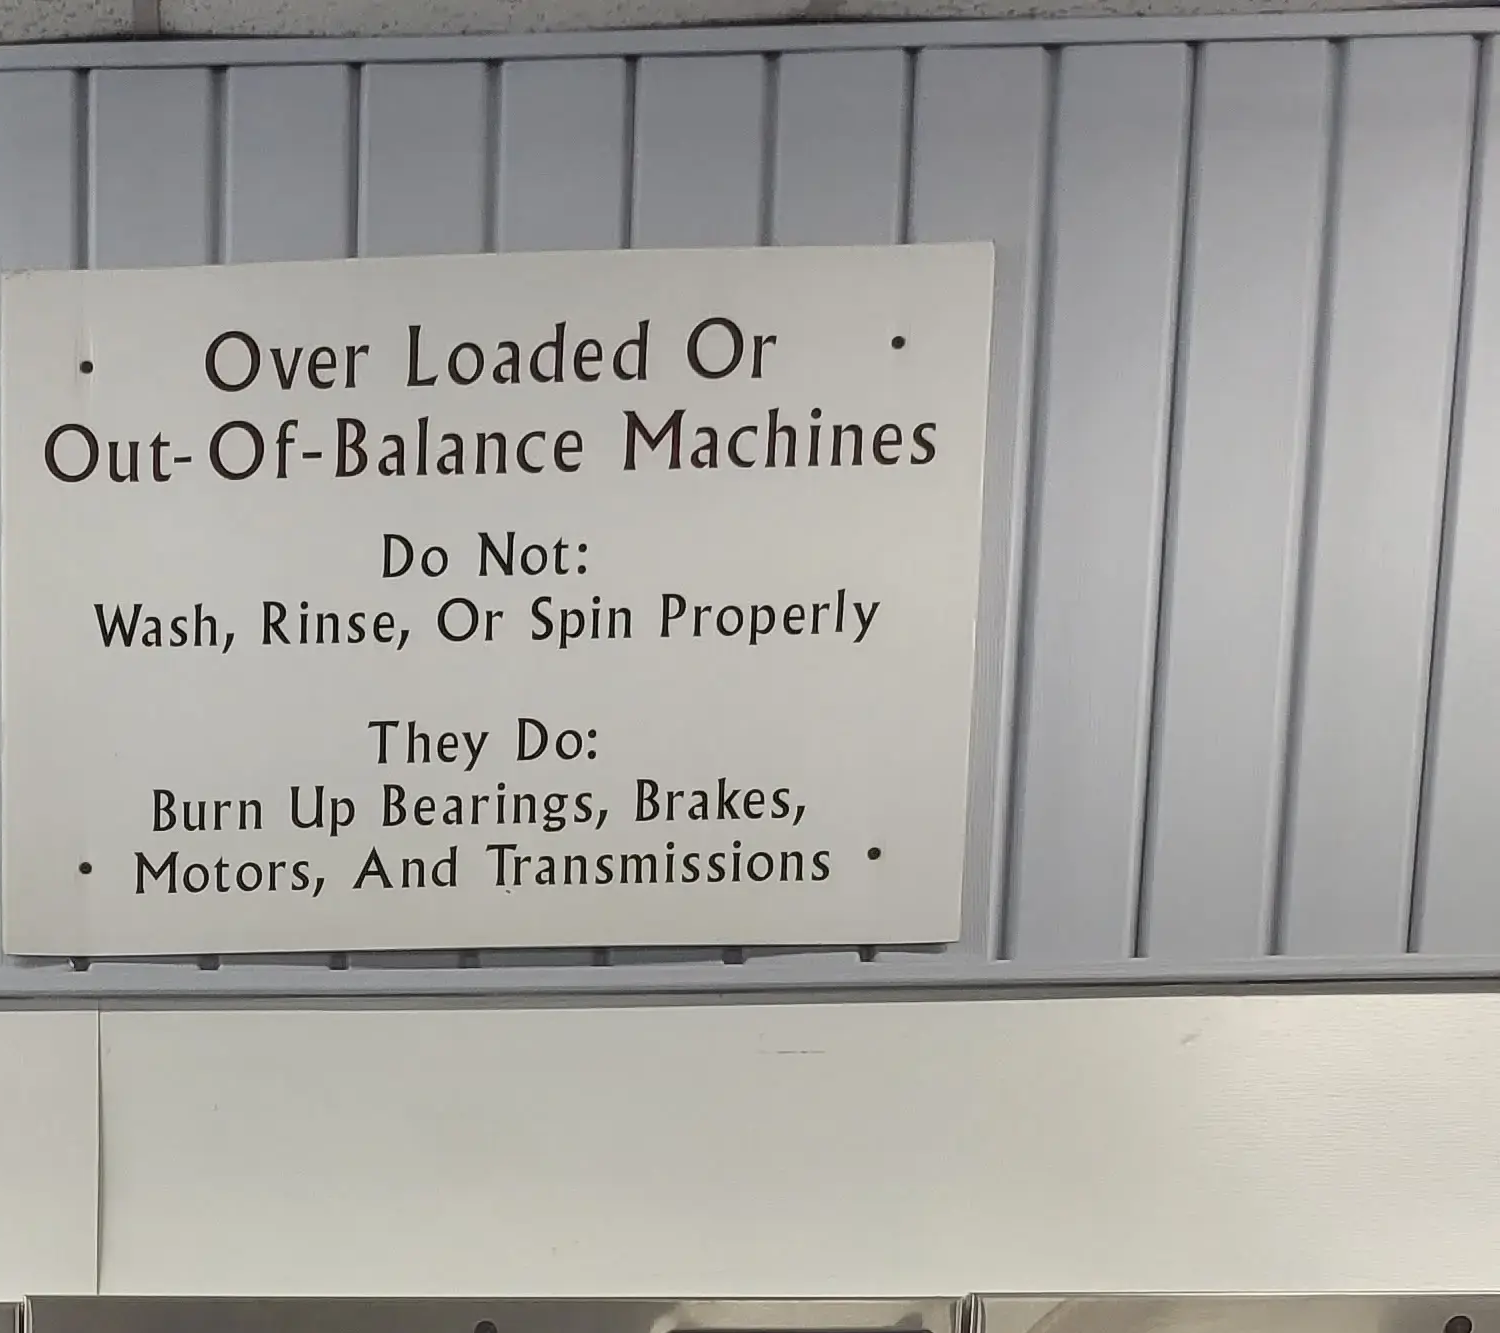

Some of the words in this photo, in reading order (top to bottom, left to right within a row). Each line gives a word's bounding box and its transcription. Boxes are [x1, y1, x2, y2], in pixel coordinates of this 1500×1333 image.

[205, 330, 370, 393] Over
[406, 319, 650, 387] Loaded
[686, 317, 777, 380] Or
[44, 415, 583, 483] Out-Of-Balance
[623, 407, 937, 471] Machines
[382, 533, 449, 578] Do
[477, 531, 588, 577] Not:
[93, 602, 235, 654] Wash,
[262, 600, 410, 651] Rinse,
[437, 597, 504, 642] Or
[531, 595, 632, 650] Spin
[660, 588, 881, 646] Properly
[367, 720, 490, 772] They
[516, 717, 597, 761] Do:
[152, 789, 262, 832] Burn
[290, 785, 355, 837] Up
[382, 782, 608, 833] Bearings,
[635, 777, 806, 826] Brakes,
[134, 851, 325, 898] Motors,
[352, 845, 458, 890] And
[485, 839, 830, 887] Transmissions
